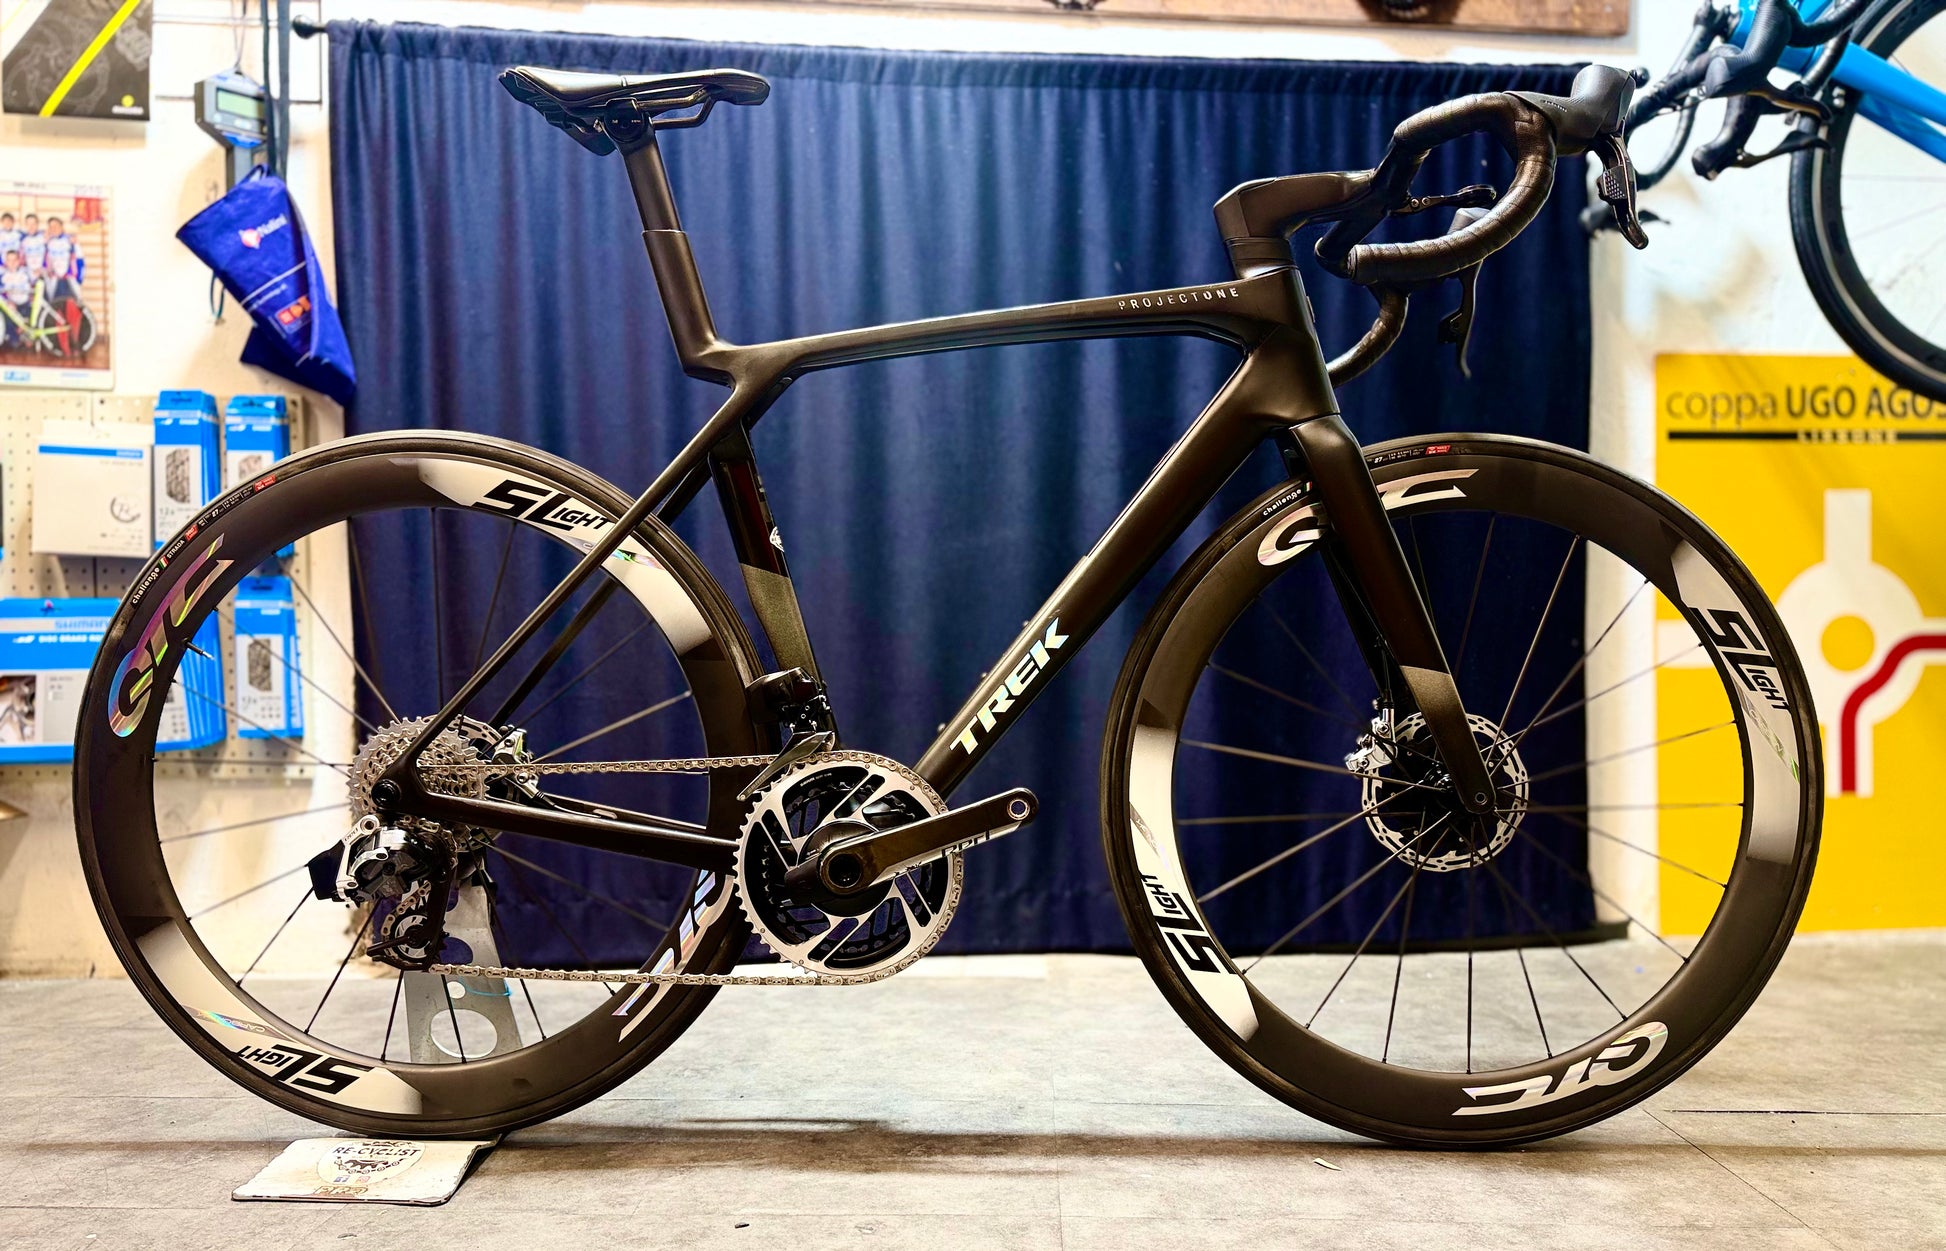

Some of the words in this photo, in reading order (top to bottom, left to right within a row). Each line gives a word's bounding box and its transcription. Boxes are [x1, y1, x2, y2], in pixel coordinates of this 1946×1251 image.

[1666, 391, 1778, 431] coppa
[1785, 386, 1857, 419] UGO
[1262, 488, 1302, 517] challenge
[132, 567, 160, 604] challenge
[166, 539, 186, 559] STRADA
[950, 617, 1070, 755] TREK
